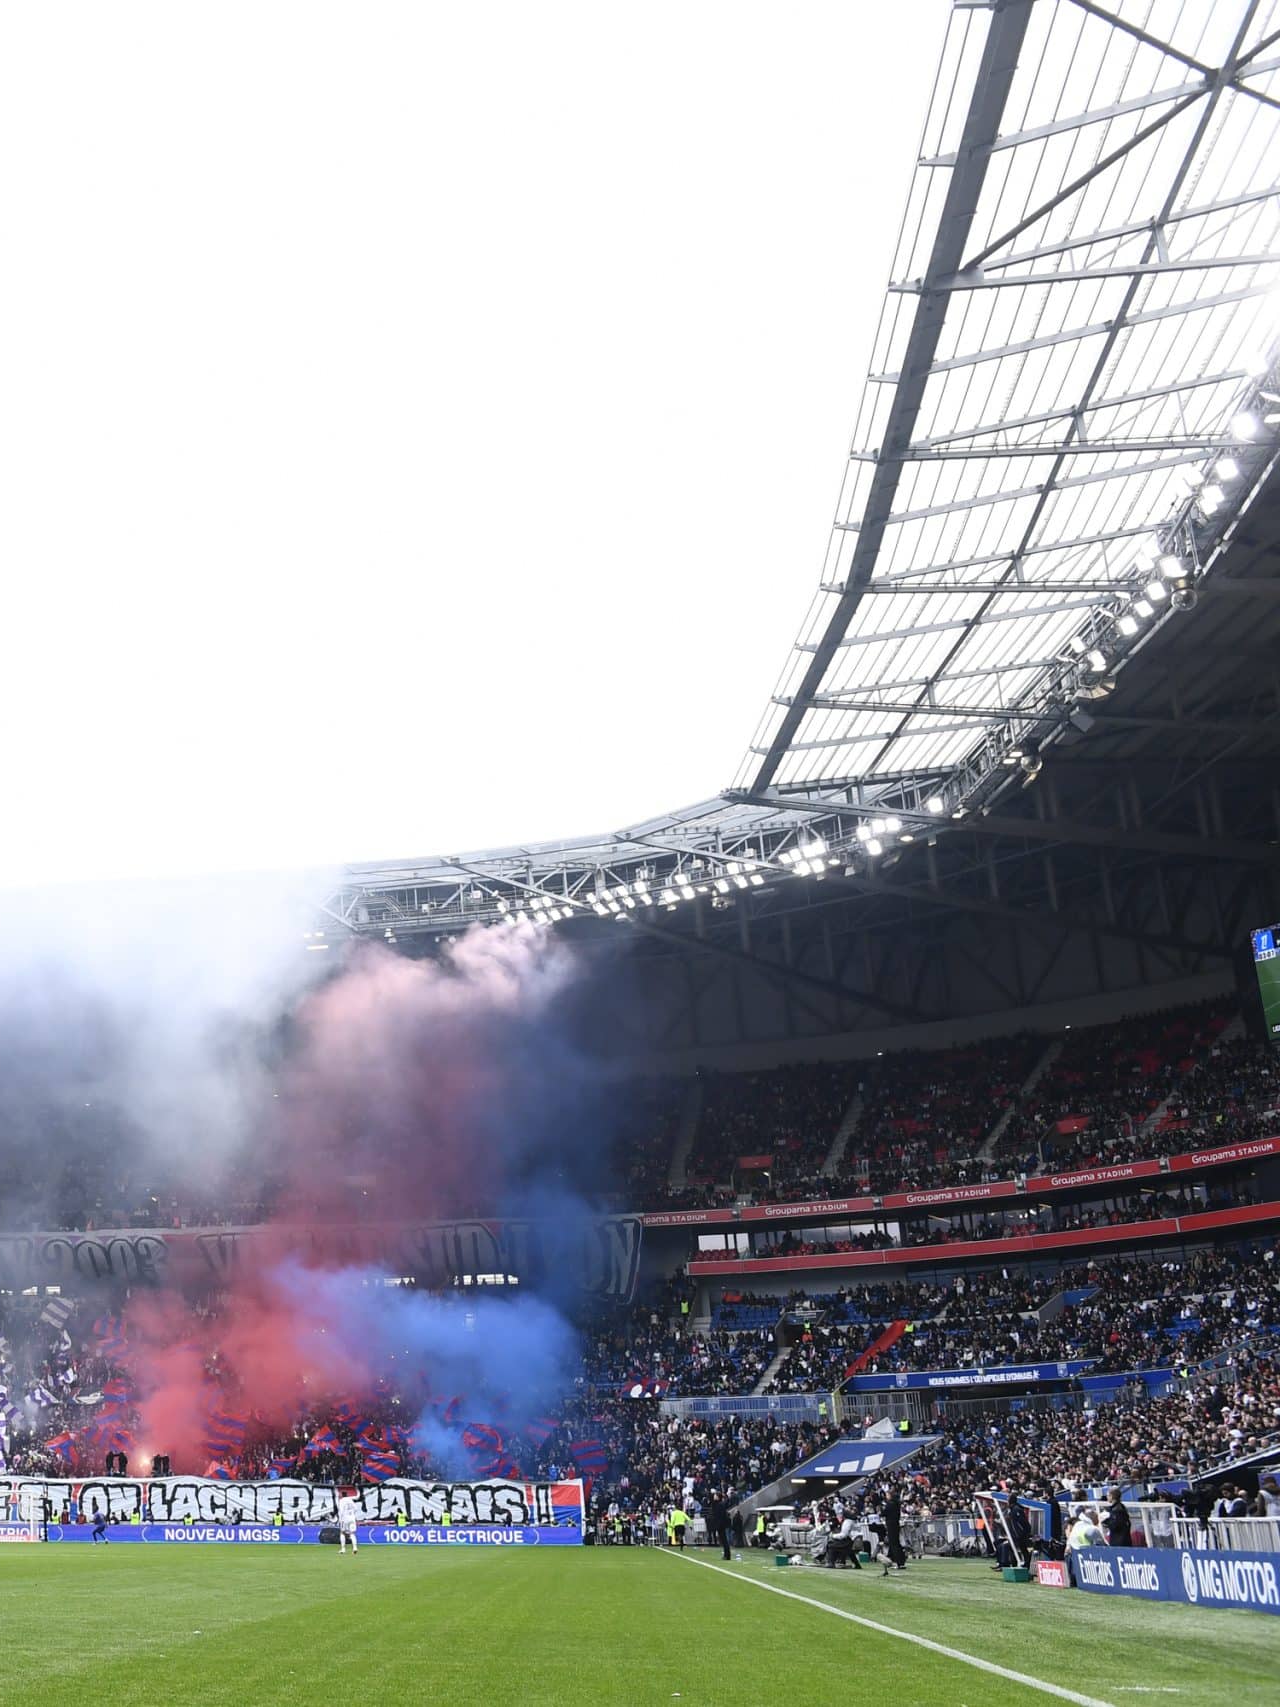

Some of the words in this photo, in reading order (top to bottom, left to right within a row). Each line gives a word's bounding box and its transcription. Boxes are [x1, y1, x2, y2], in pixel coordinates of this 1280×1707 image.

[1191, 1148, 1236, 1165] Groupama
[1238, 1142, 1274, 1157] STADIUM
[1050, 1172, 1095, 1187] Groupama
[1097, 1167, 1134, 1180] STADIUM
[906, 1191, 953, 1204] Groupama
[955, 1187, 991, 1199] STADIUM
[671, 1213, 707, 1222] STADIUM
[765, 1205, 811, 1217] Groupama
[812, 1203, 849, 1212] STADIUM
[164, 1528, 233, 1542] NOUVEAU
[238, 1529, 280, 1542] MGS5
[383, 1530, 424, 1544] 100%
[426, 1527, 524, 1547] ÉLECTRIQUE
[1077, 1553, 1115, 1588] Emirates
[1117, 1556, 1160, 1592] Emirates
[1196, 1559, 1221, 1599] MG
[1220, 1560, 1280, 1605] MOTOR
